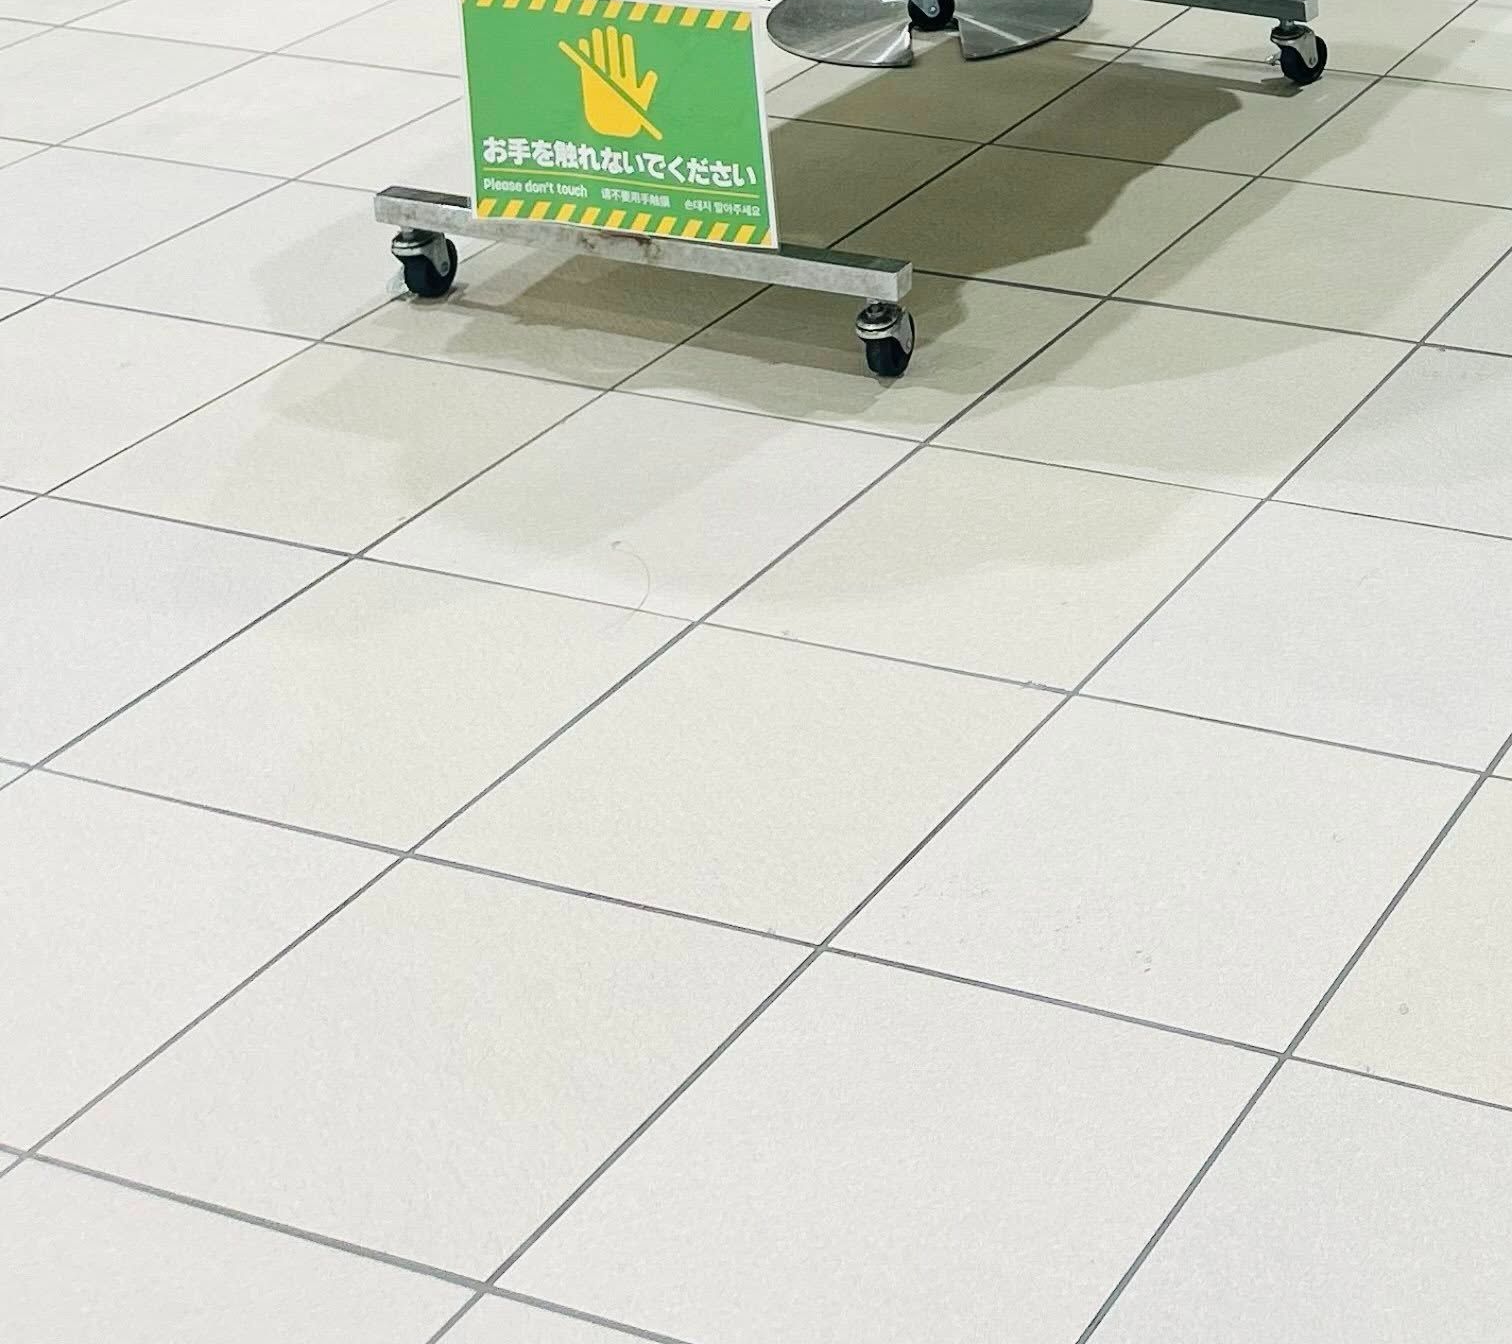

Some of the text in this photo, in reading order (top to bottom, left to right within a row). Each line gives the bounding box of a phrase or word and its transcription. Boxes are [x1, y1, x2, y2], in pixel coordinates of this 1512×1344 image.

[482, 135, 758, 188] お手を触れないでください
[483, 177, 588, 198] Please don't touch
